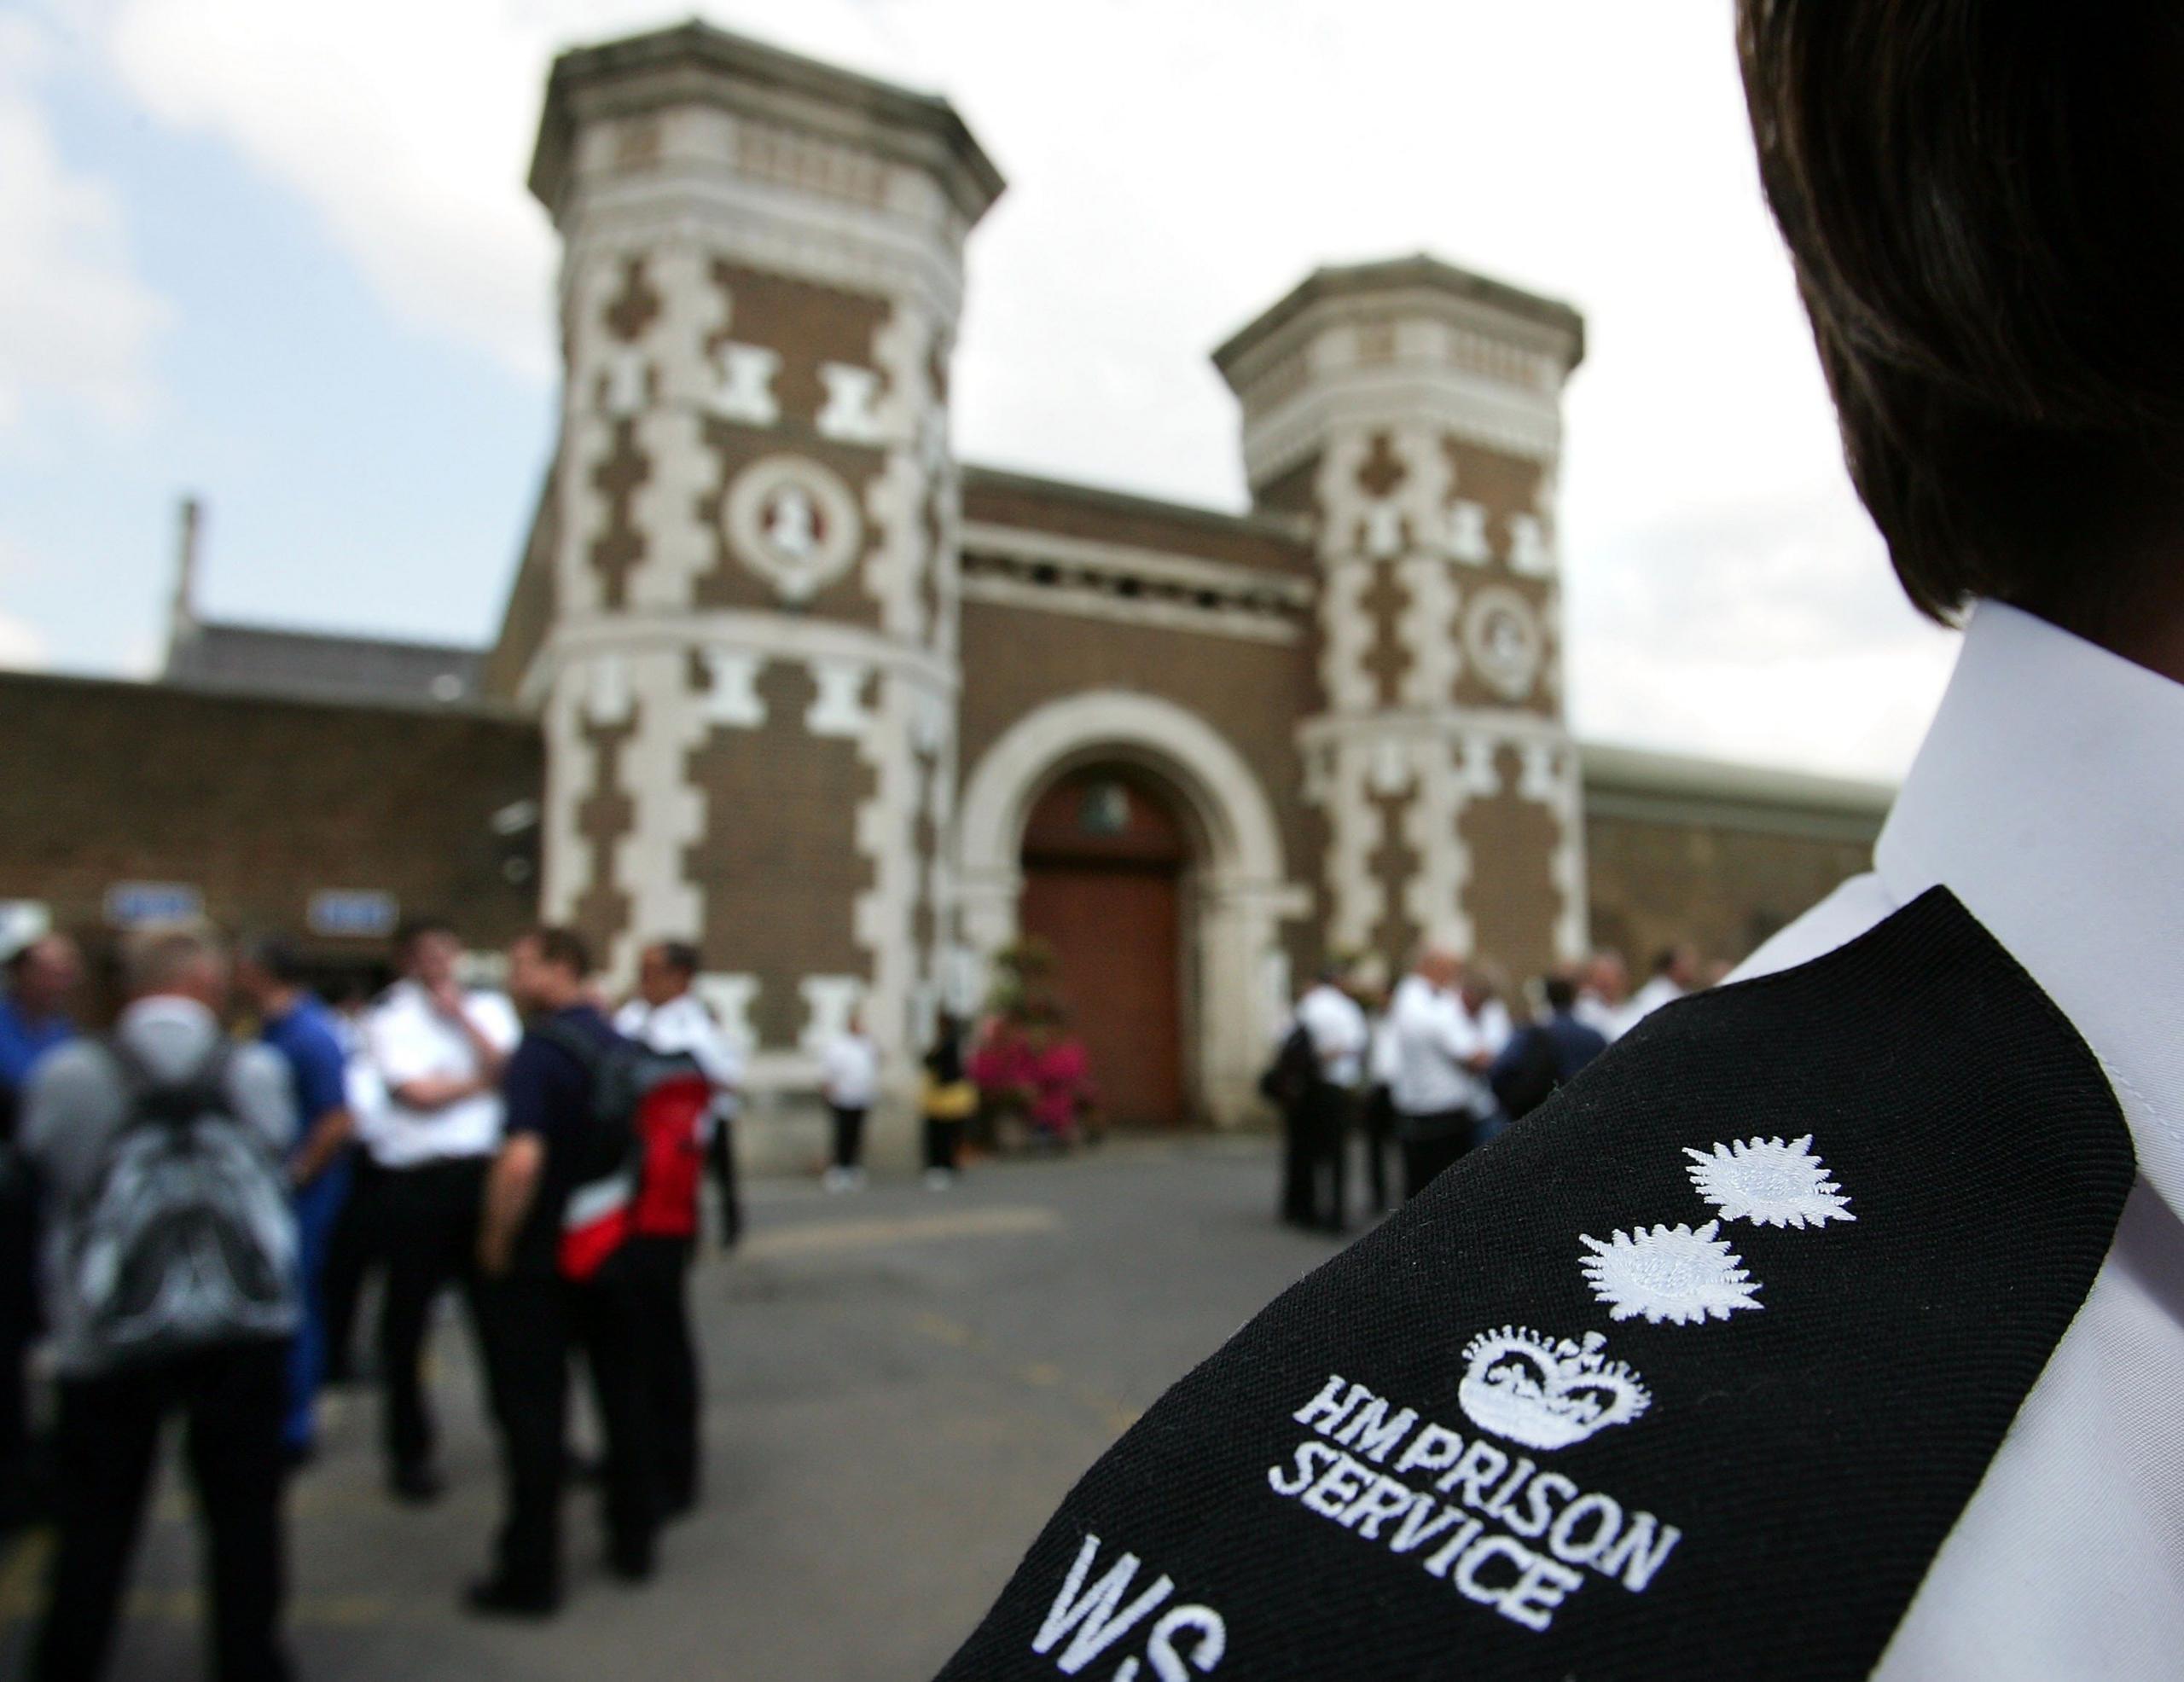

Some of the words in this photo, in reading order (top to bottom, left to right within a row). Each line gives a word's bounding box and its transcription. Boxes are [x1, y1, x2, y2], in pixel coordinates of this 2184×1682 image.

[1268, 1441, 1583, 1630] SERVICE
[1292, 1374, 1419, 1463] HM
[1393, 1423, 1681, 1592] PRISON
